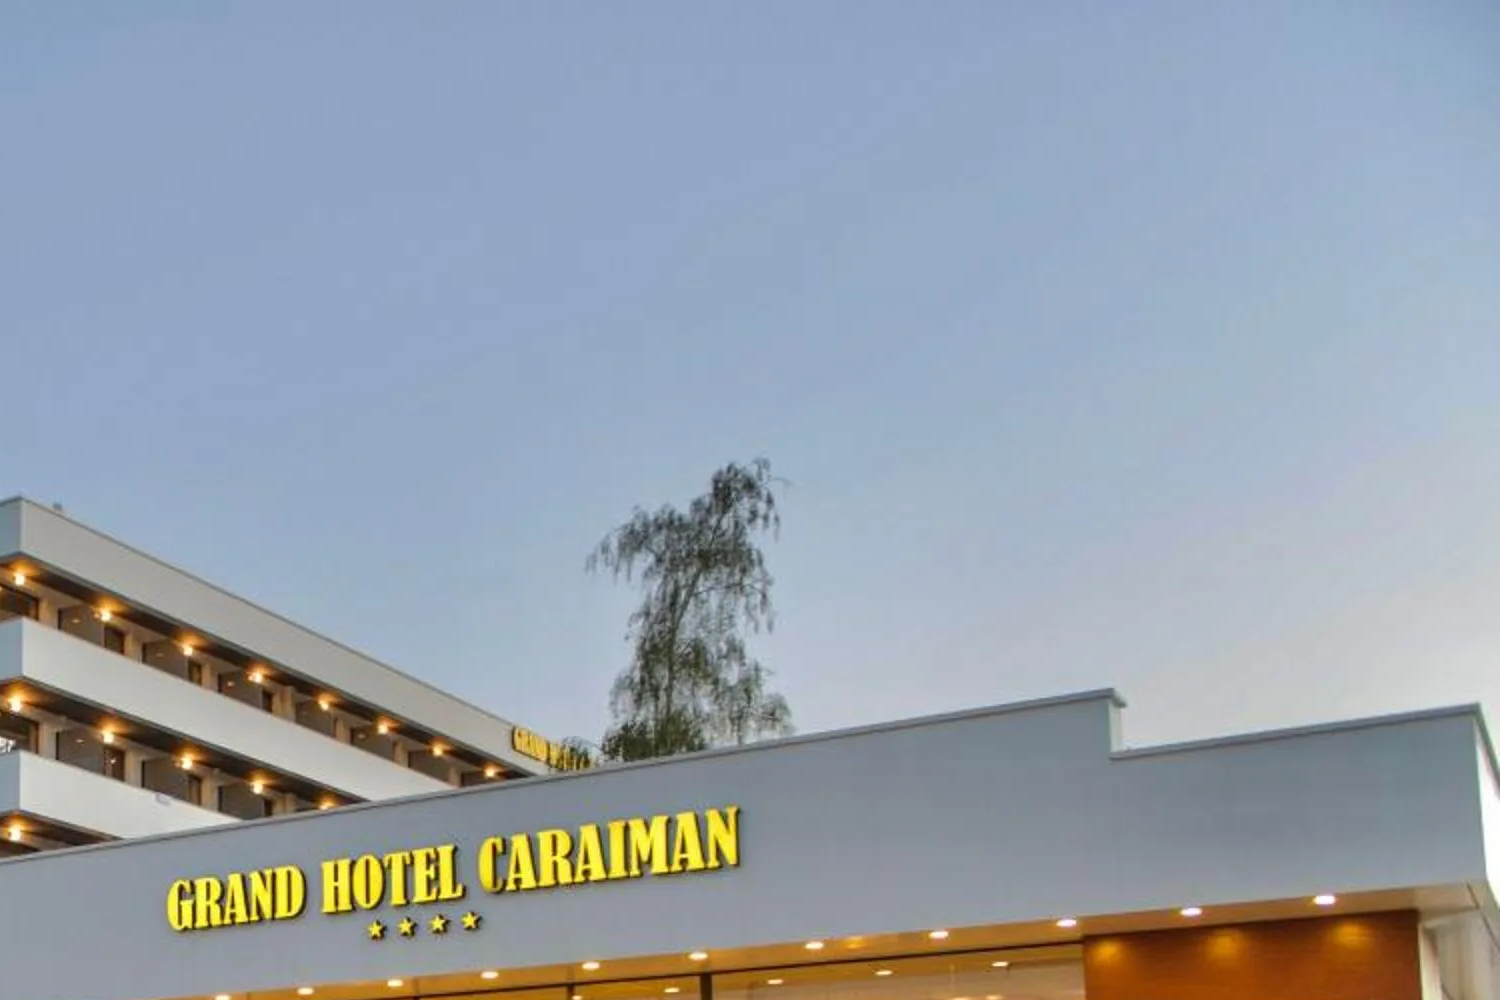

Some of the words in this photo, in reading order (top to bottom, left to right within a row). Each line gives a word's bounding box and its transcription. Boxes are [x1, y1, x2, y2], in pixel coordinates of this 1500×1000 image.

[166, 866, 305, 931] GRAND
[321, 845, 464, 914] HOTEL
[478, 806, 740, 894] CARAIMAN
